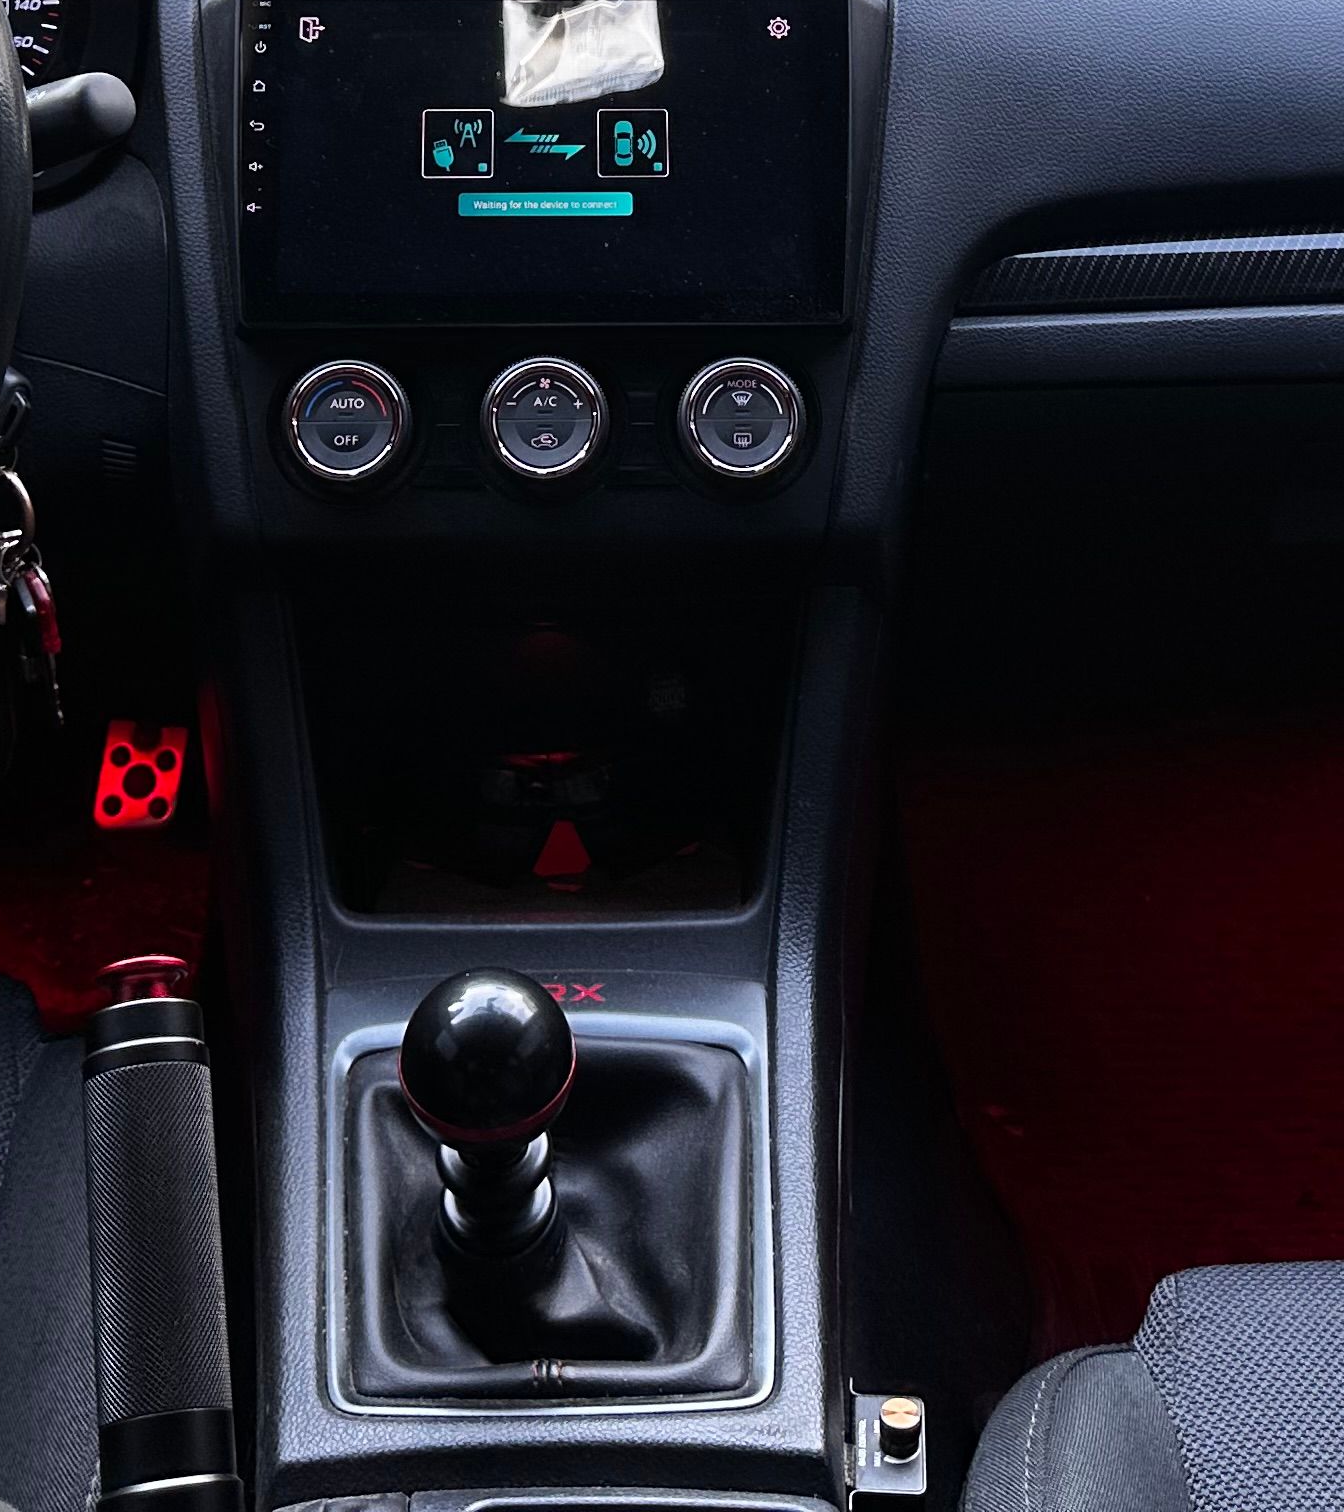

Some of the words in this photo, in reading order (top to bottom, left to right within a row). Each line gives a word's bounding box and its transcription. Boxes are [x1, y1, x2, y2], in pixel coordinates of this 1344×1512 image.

[14, 0, 42, 11] 140
[12, 37, 34, 48] 60
[473, 201, 507, 211] Waiting
[509, 201, 522, 209] for
[524, 201, 538, 209] the
[540, 200, 568, 209] device
[571, 201, 580, 209] to
[582, 201, 618, 209] connect
[727, 379, 757, 388] MODE
[330, 398, 365, 409] AUTO
[533, 395, 557, 407] A/C
[334, 435, 359, 446] OFF
[542, 983, 606, 1002] RX
